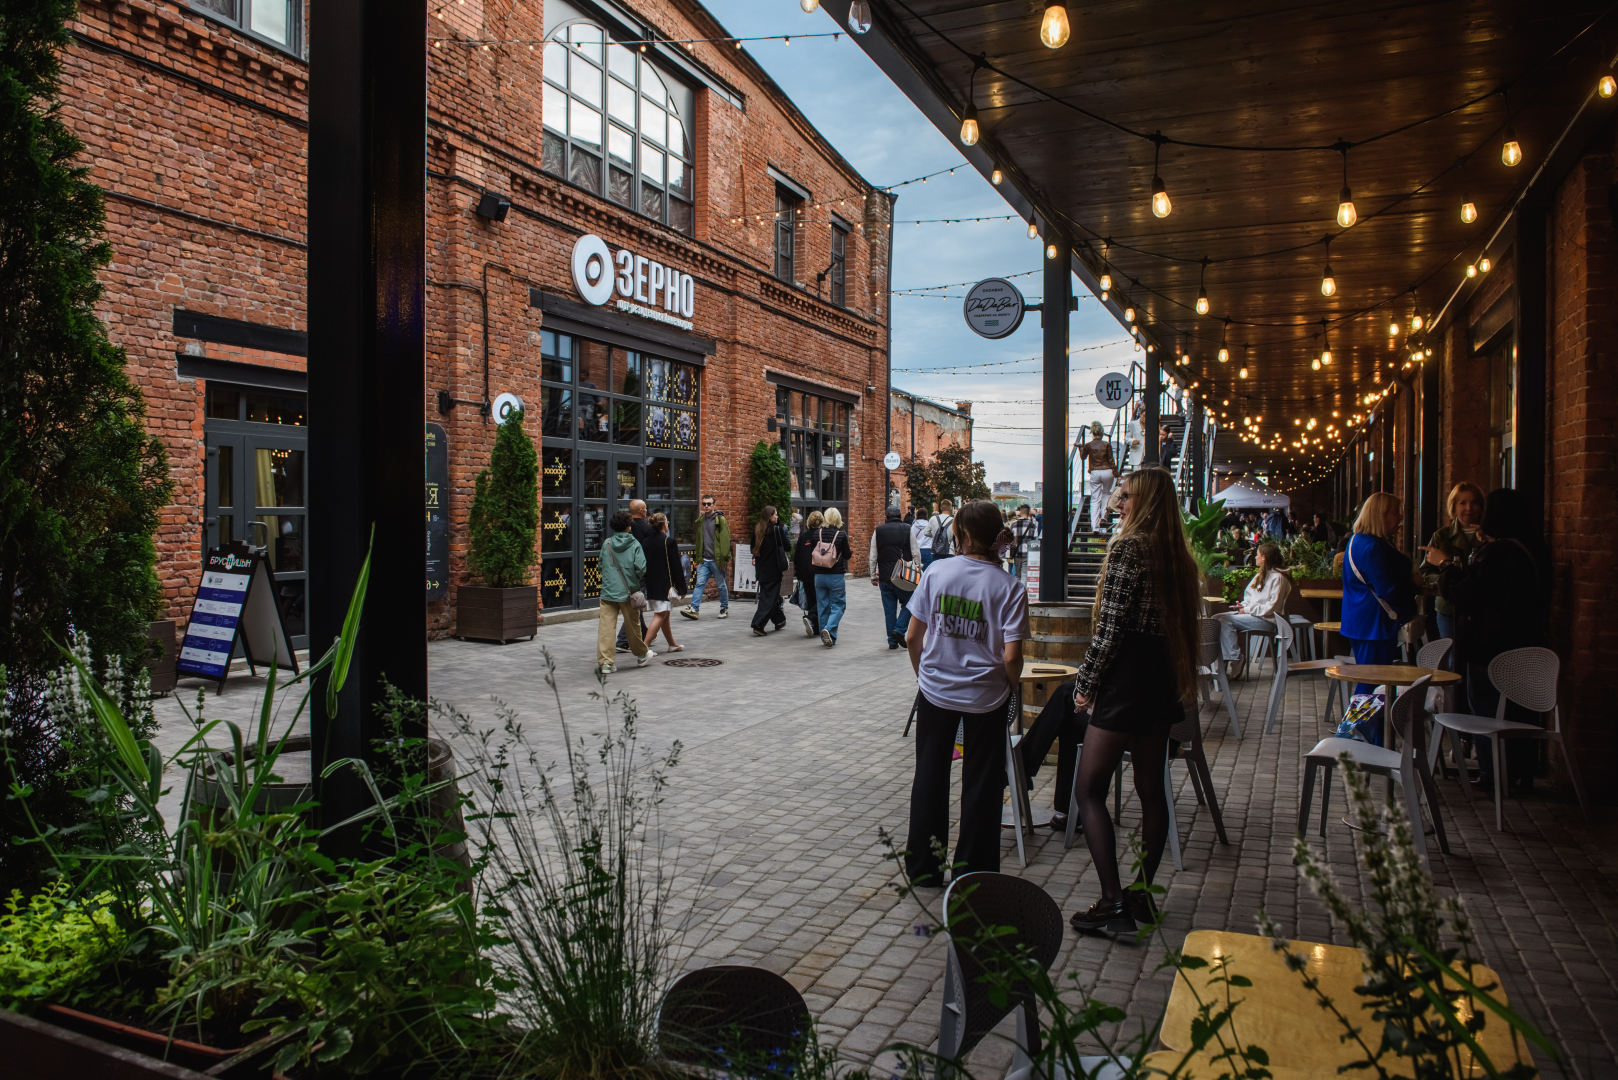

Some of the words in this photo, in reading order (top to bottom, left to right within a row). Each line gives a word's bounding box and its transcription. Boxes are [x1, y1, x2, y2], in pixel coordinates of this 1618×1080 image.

[616, 250, 694, 318] ЗЕРНО
[968, 296, 1019, 312] DaDaBar
[1106, 380, 1122, 390] MI
[938, 594, 983, 621] MEDIA
[931, 612, 989, 643] FASHION
